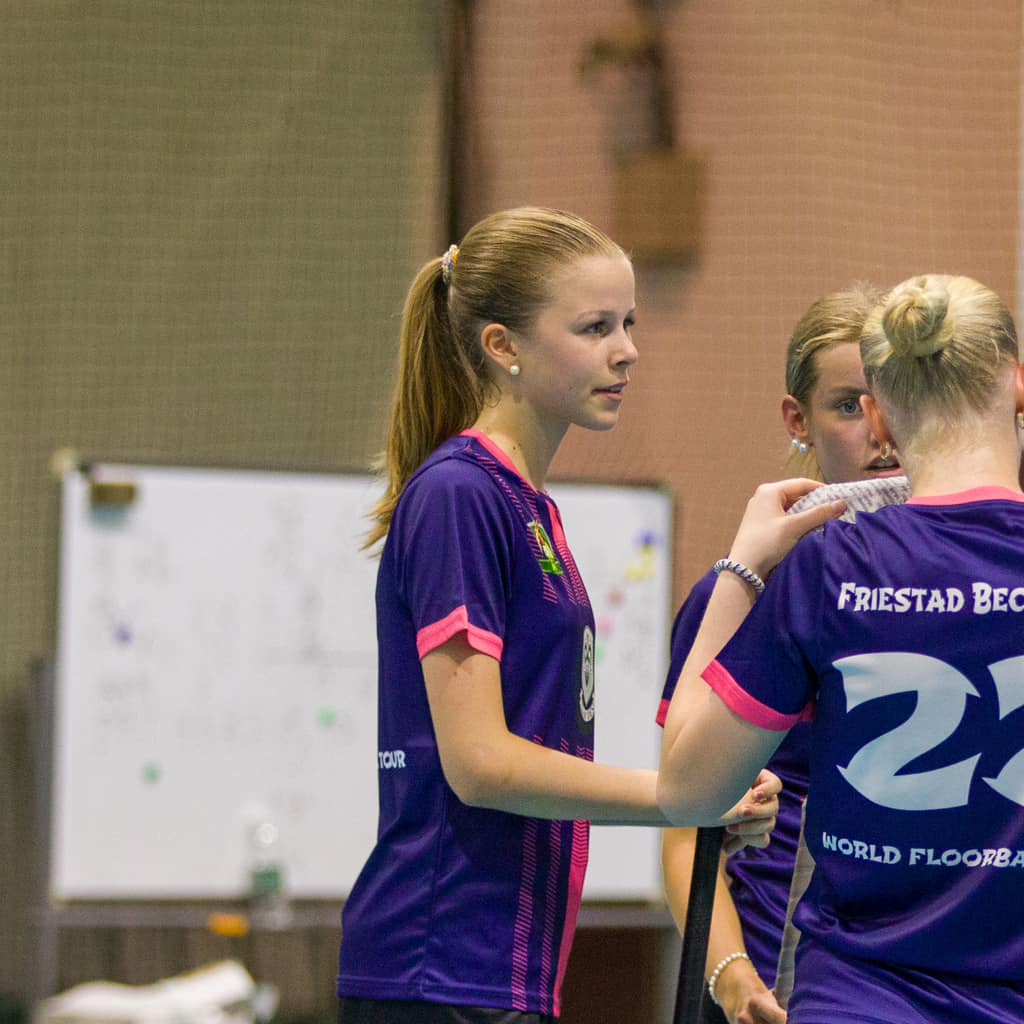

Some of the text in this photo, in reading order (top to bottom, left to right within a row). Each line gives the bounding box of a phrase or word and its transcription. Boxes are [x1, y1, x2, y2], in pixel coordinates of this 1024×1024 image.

[837, 582, 965, 614] FRIESTAD
[378, 750, 406, 769] TOUR
[822, 831, 902, 865] WORLD
